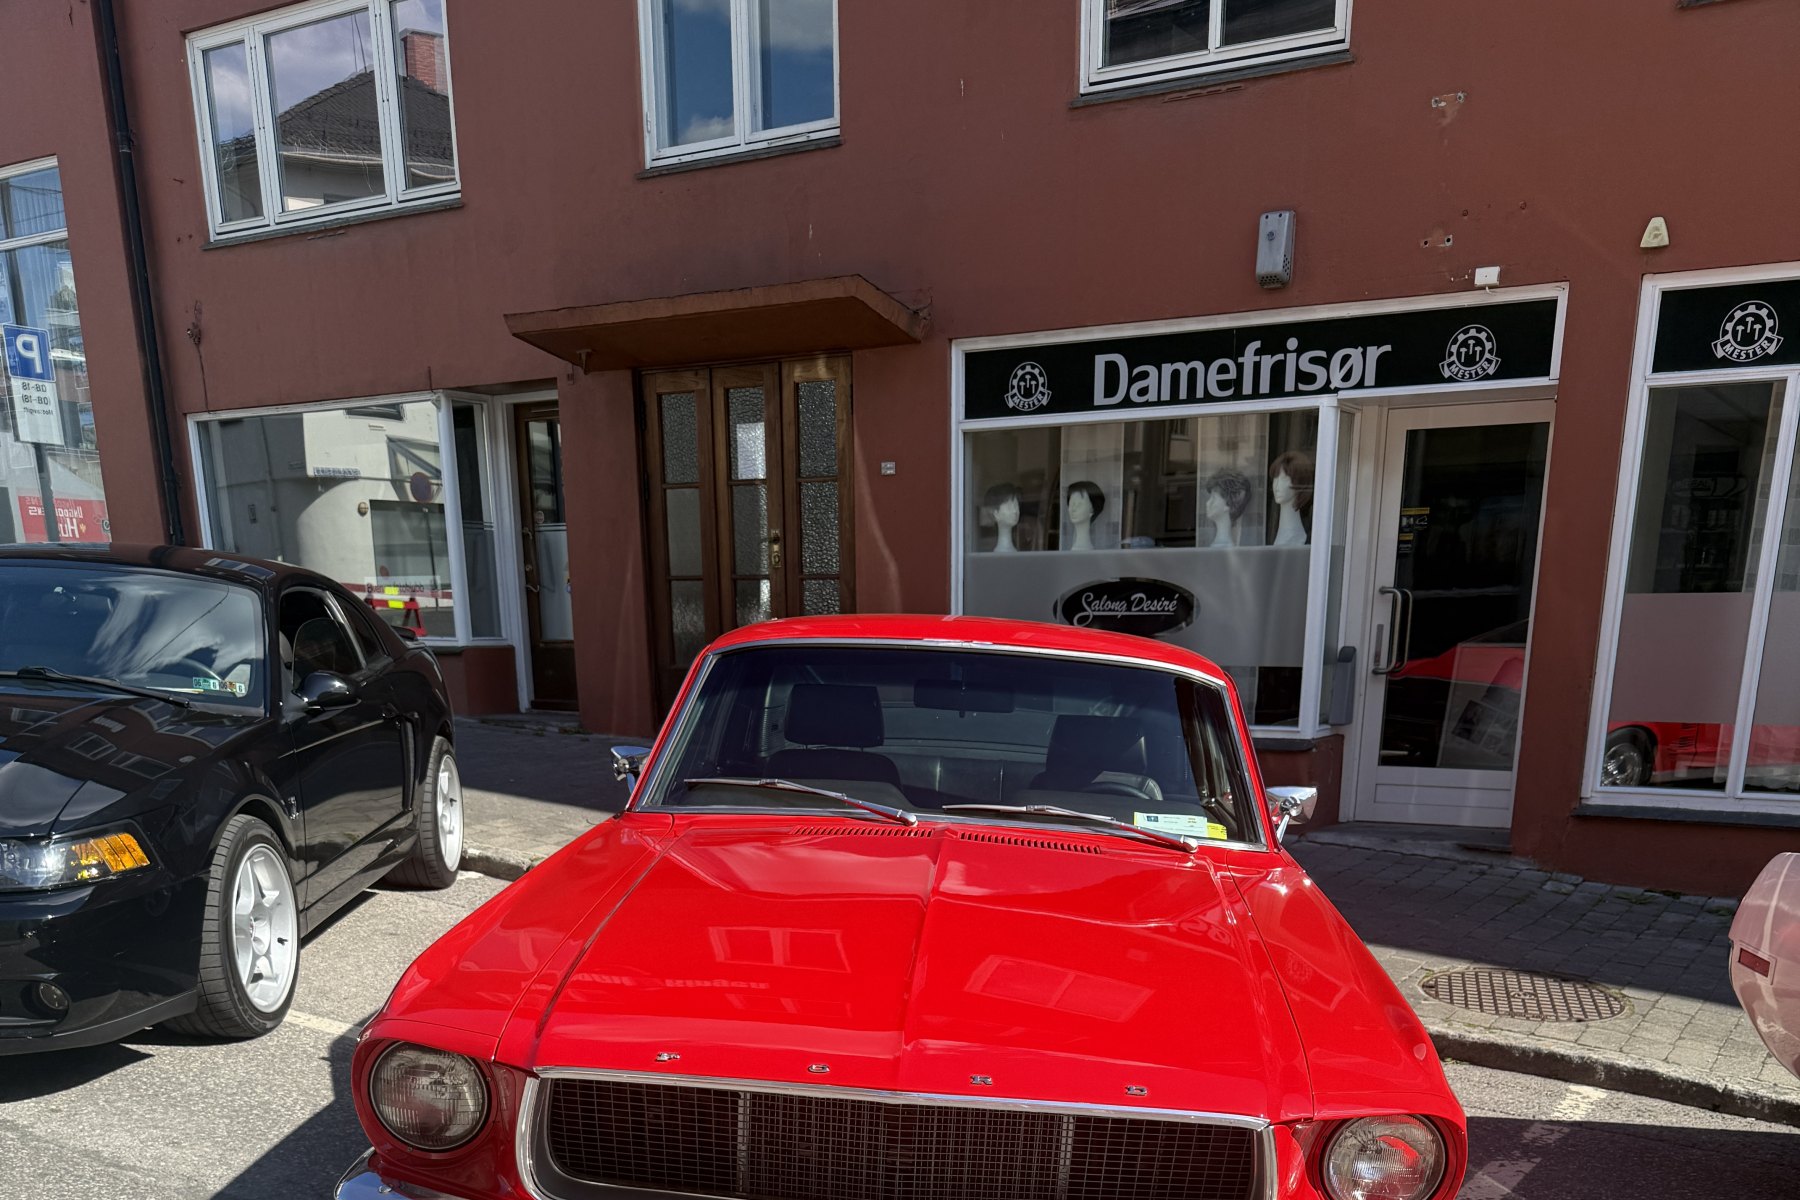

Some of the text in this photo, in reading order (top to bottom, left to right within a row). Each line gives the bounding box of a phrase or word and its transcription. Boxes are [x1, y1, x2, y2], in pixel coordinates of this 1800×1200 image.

[1722, 340, 1772, 360] MESTER
[1093, 337, 1392, 407] Damefrisør
[1448, 361, 1491, 379] MESTER
[1012, 393, 1044, 409] MESTER
[1073, 592, 1179, 627] Salong Desiré
